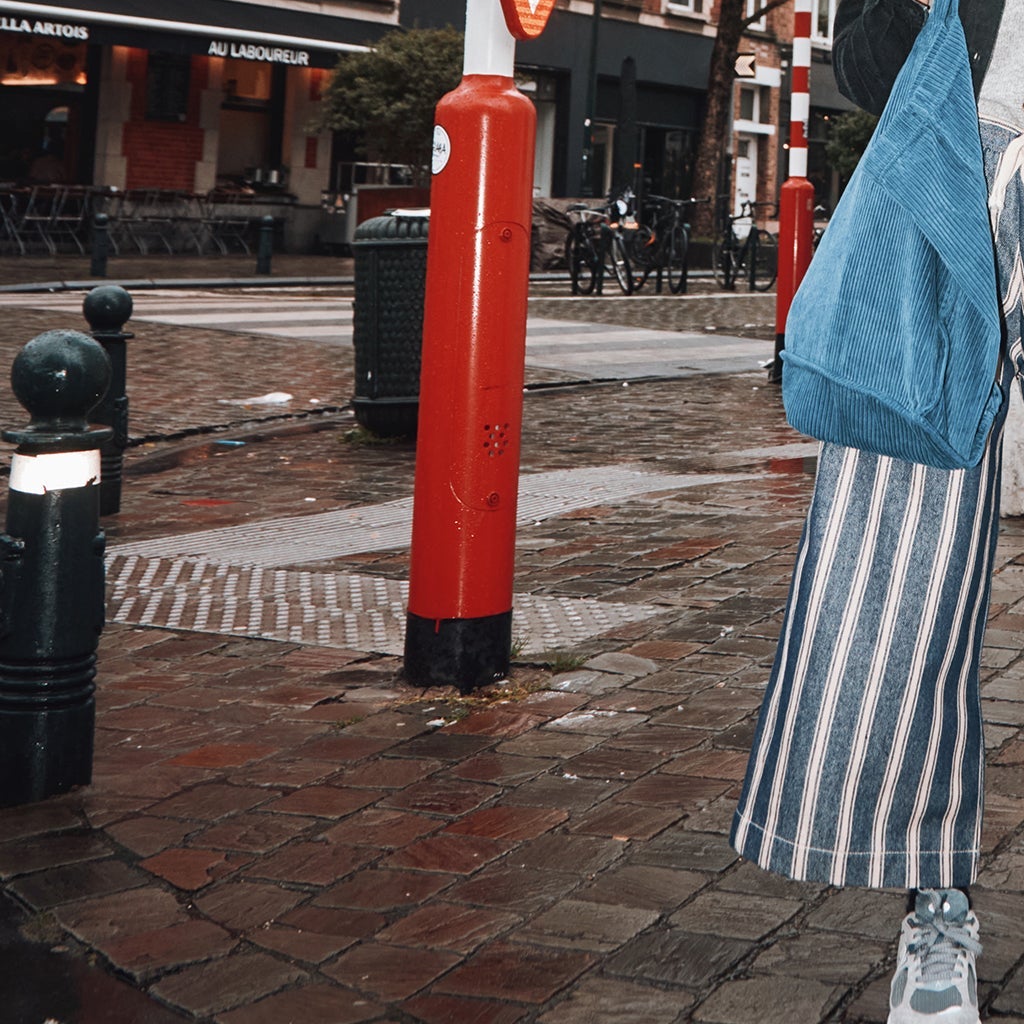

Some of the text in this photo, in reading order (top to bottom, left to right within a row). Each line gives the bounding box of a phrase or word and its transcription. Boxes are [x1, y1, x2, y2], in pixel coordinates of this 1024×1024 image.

[0, 17, 89, 40] LLA ARTOIS
[208, 41, 309, 66] AU LABOUREUR
